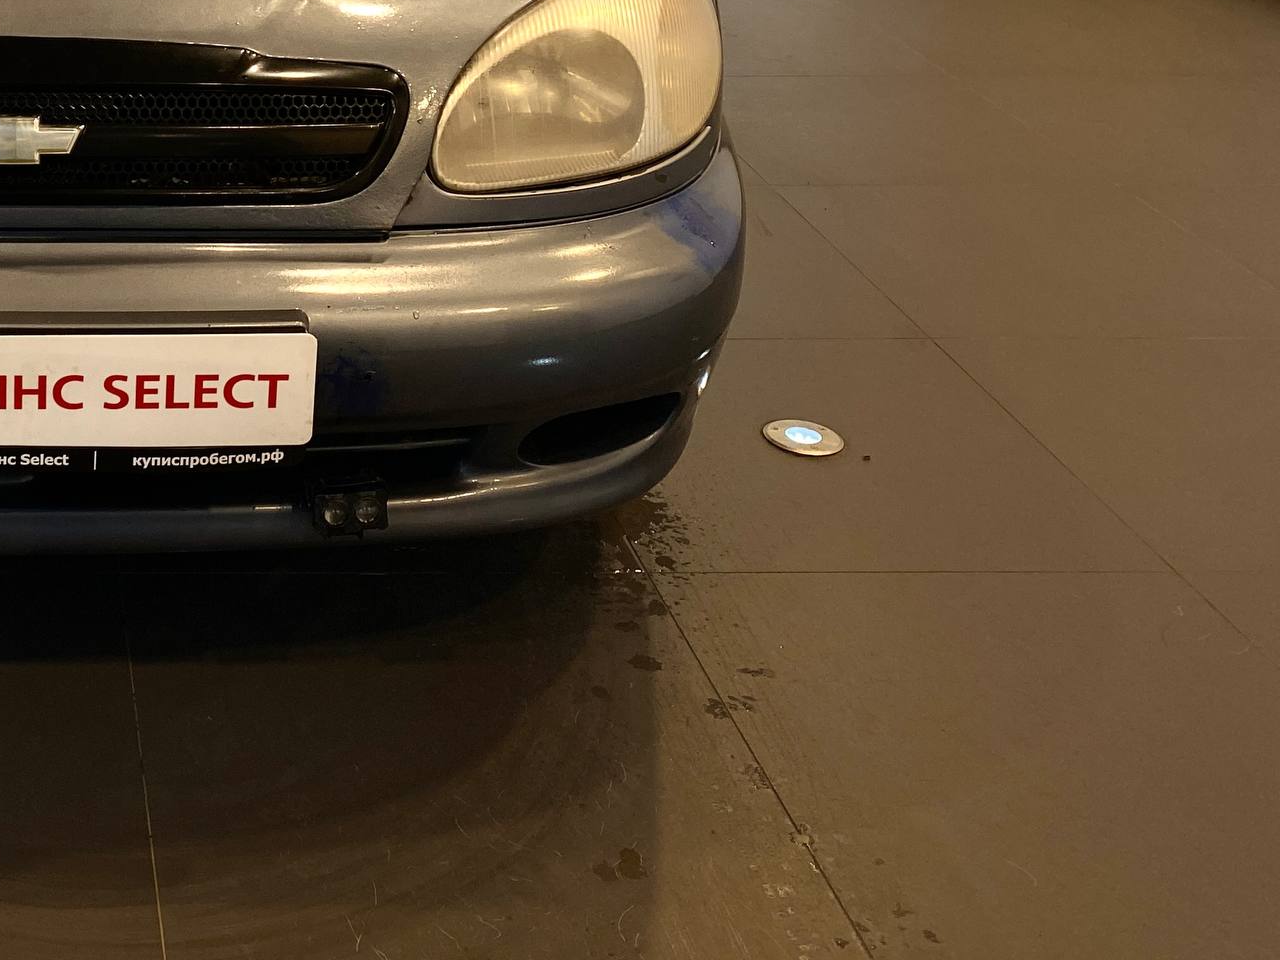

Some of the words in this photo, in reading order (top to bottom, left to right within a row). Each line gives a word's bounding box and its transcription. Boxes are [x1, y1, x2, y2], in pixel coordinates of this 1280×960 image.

[102, 372, 290, 411] SELECT
[20, 453, 70, 467] Select
[132, 448, 285, 469] куписпробегом.рф
